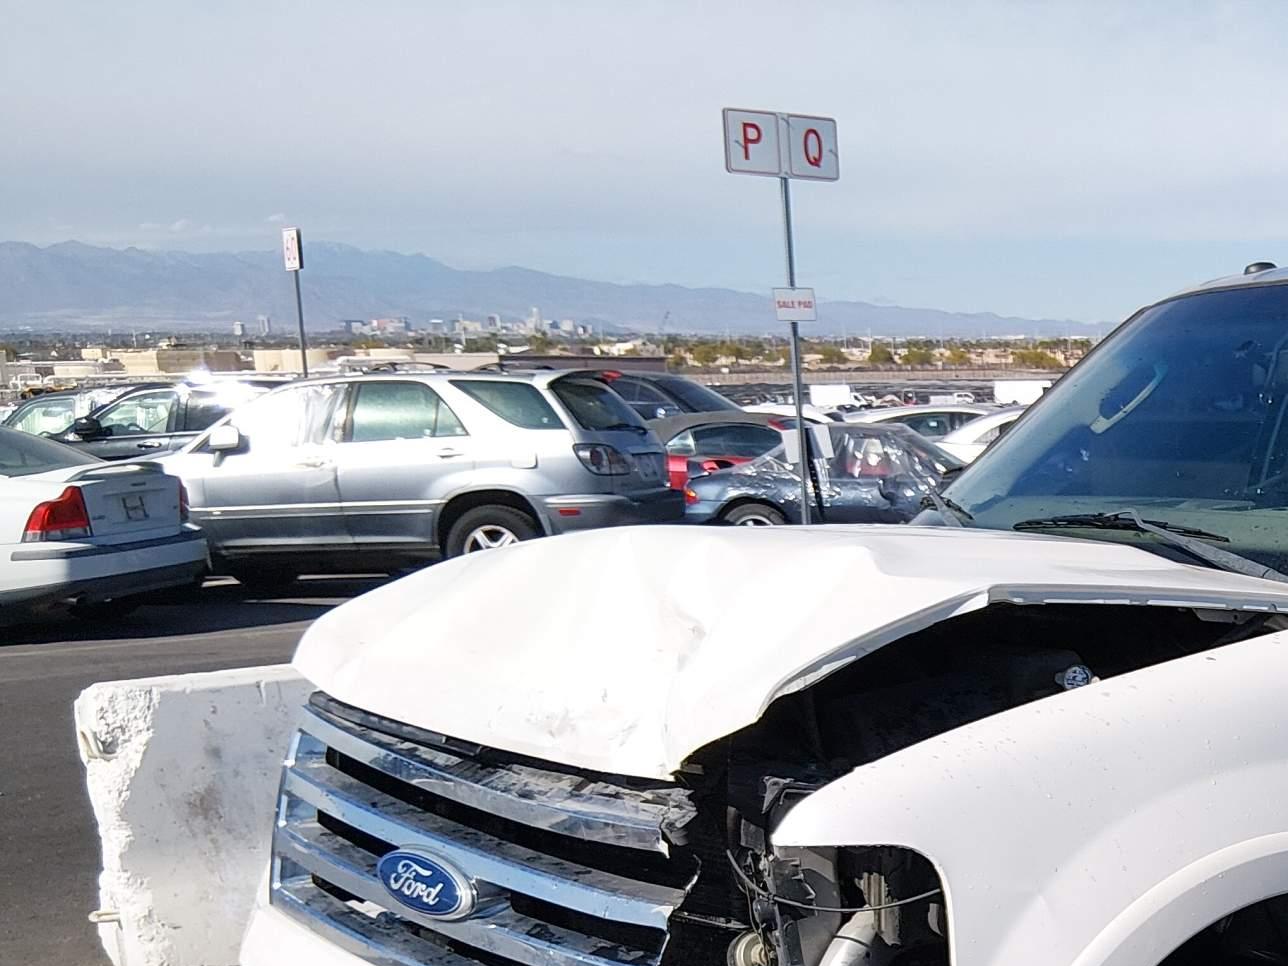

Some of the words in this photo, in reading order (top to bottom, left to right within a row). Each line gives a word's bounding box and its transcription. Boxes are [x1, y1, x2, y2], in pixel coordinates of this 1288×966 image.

[742, 121, 763, 161] P
[803, 128, 823, 168] Q
[390, 859, 445, 906] Ford
